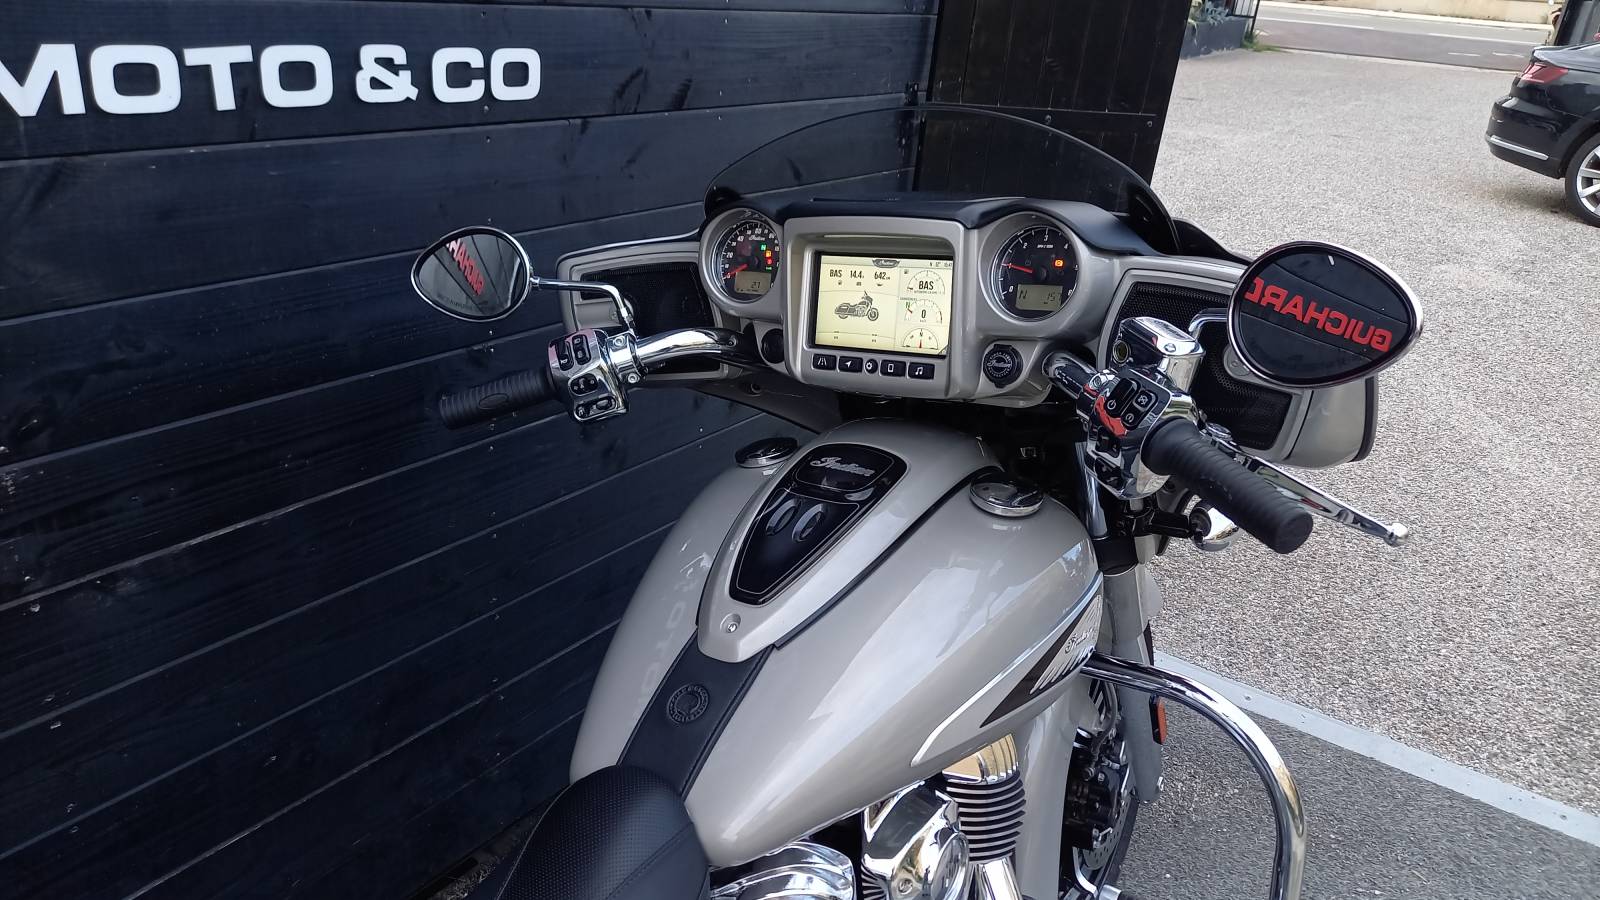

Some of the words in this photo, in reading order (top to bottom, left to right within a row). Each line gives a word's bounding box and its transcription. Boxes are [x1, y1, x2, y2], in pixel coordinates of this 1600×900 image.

[0, 43, 334, 117] MOTO
[355, 43, 419, 103] &
[431, 46, 541, 103] CO
[829, 269, 843, 278] BAS
[918, 280, 934, 290] BAS
[921, 309, 926, 319] 0
[810, 456, 876, 477] Indian
